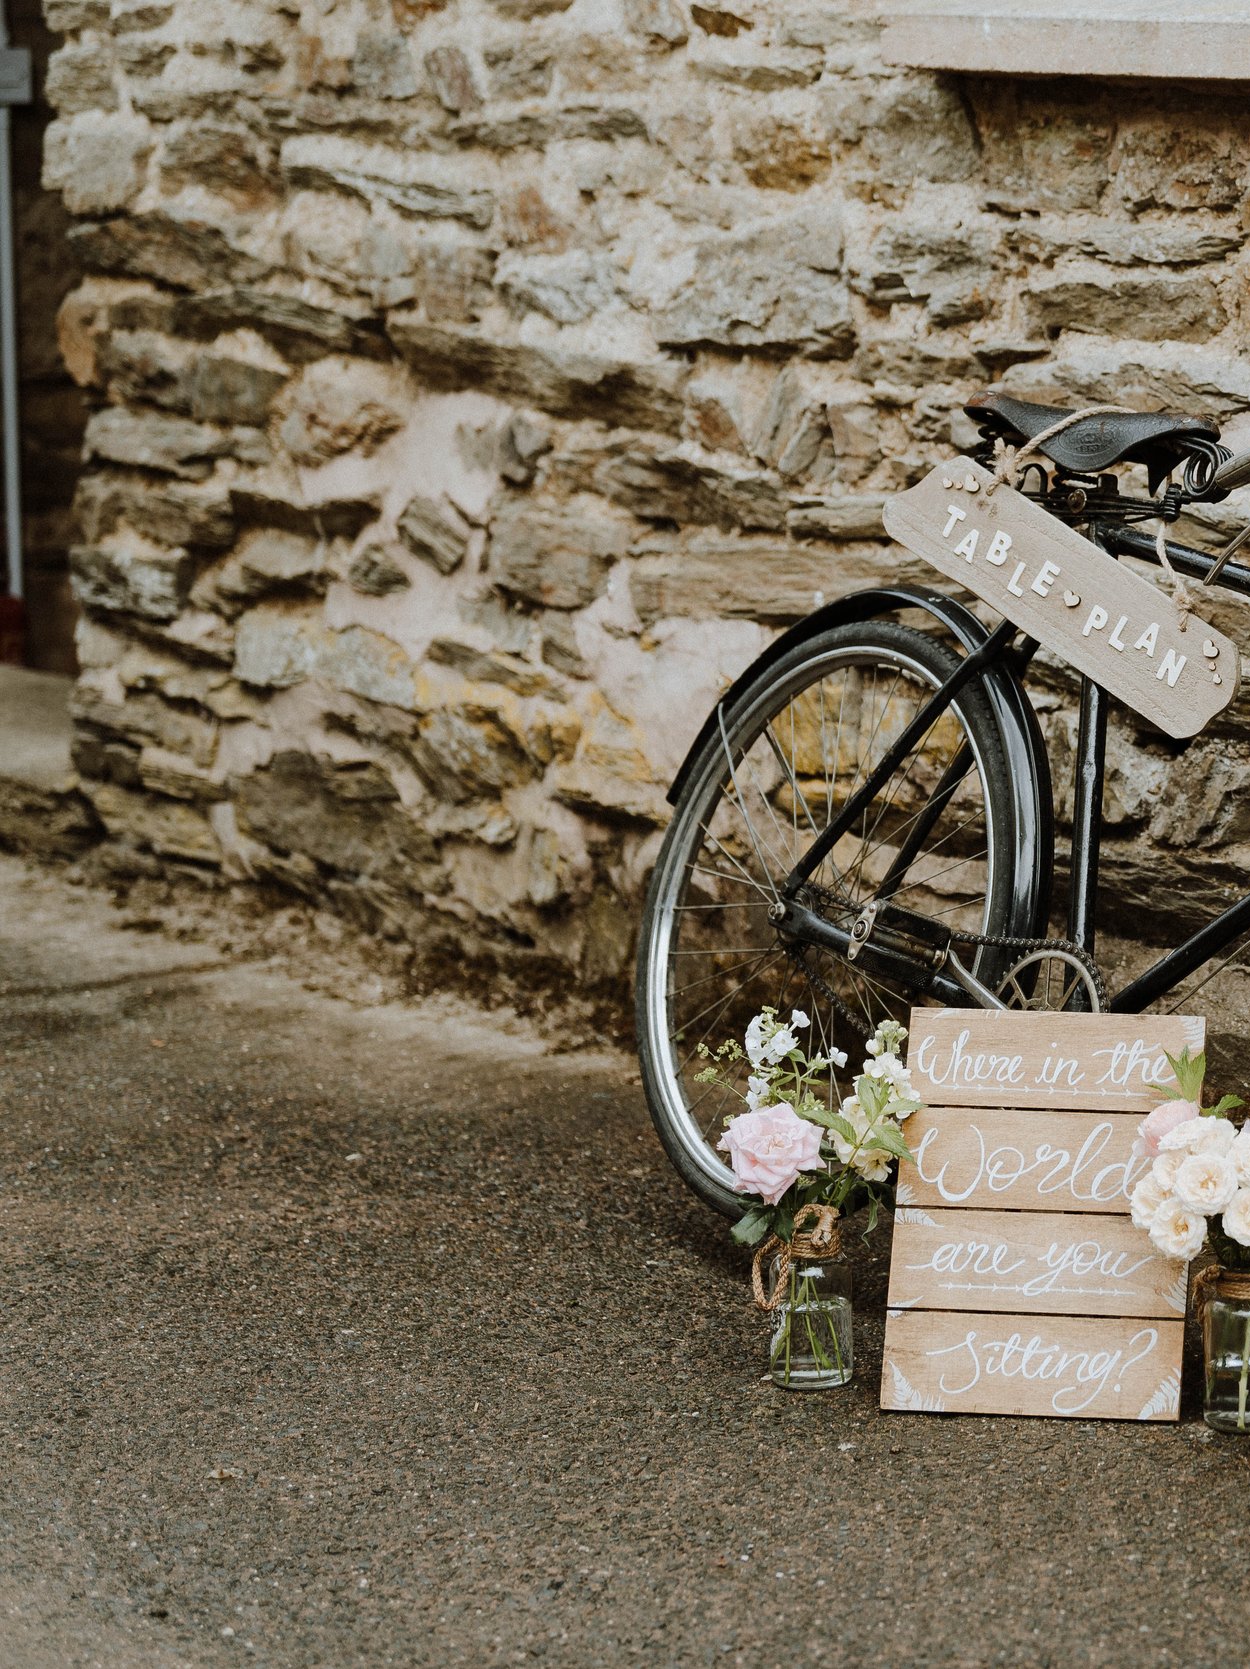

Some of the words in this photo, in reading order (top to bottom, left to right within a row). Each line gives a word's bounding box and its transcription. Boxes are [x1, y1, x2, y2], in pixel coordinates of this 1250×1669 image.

[942, 504, 1061, 598] TABLE
[1082, 604, 1188, 688] PLAN
[907, 1029, 1027, 1085] Where
[1035, 1041, 1085, 1086] in
[1091, 1038, 1177, 1085] the
[910, 1122, 1150, 1202] World
[905, 1241, 1026, 1275] are
[1022, 1239, 1156, 1297] you
